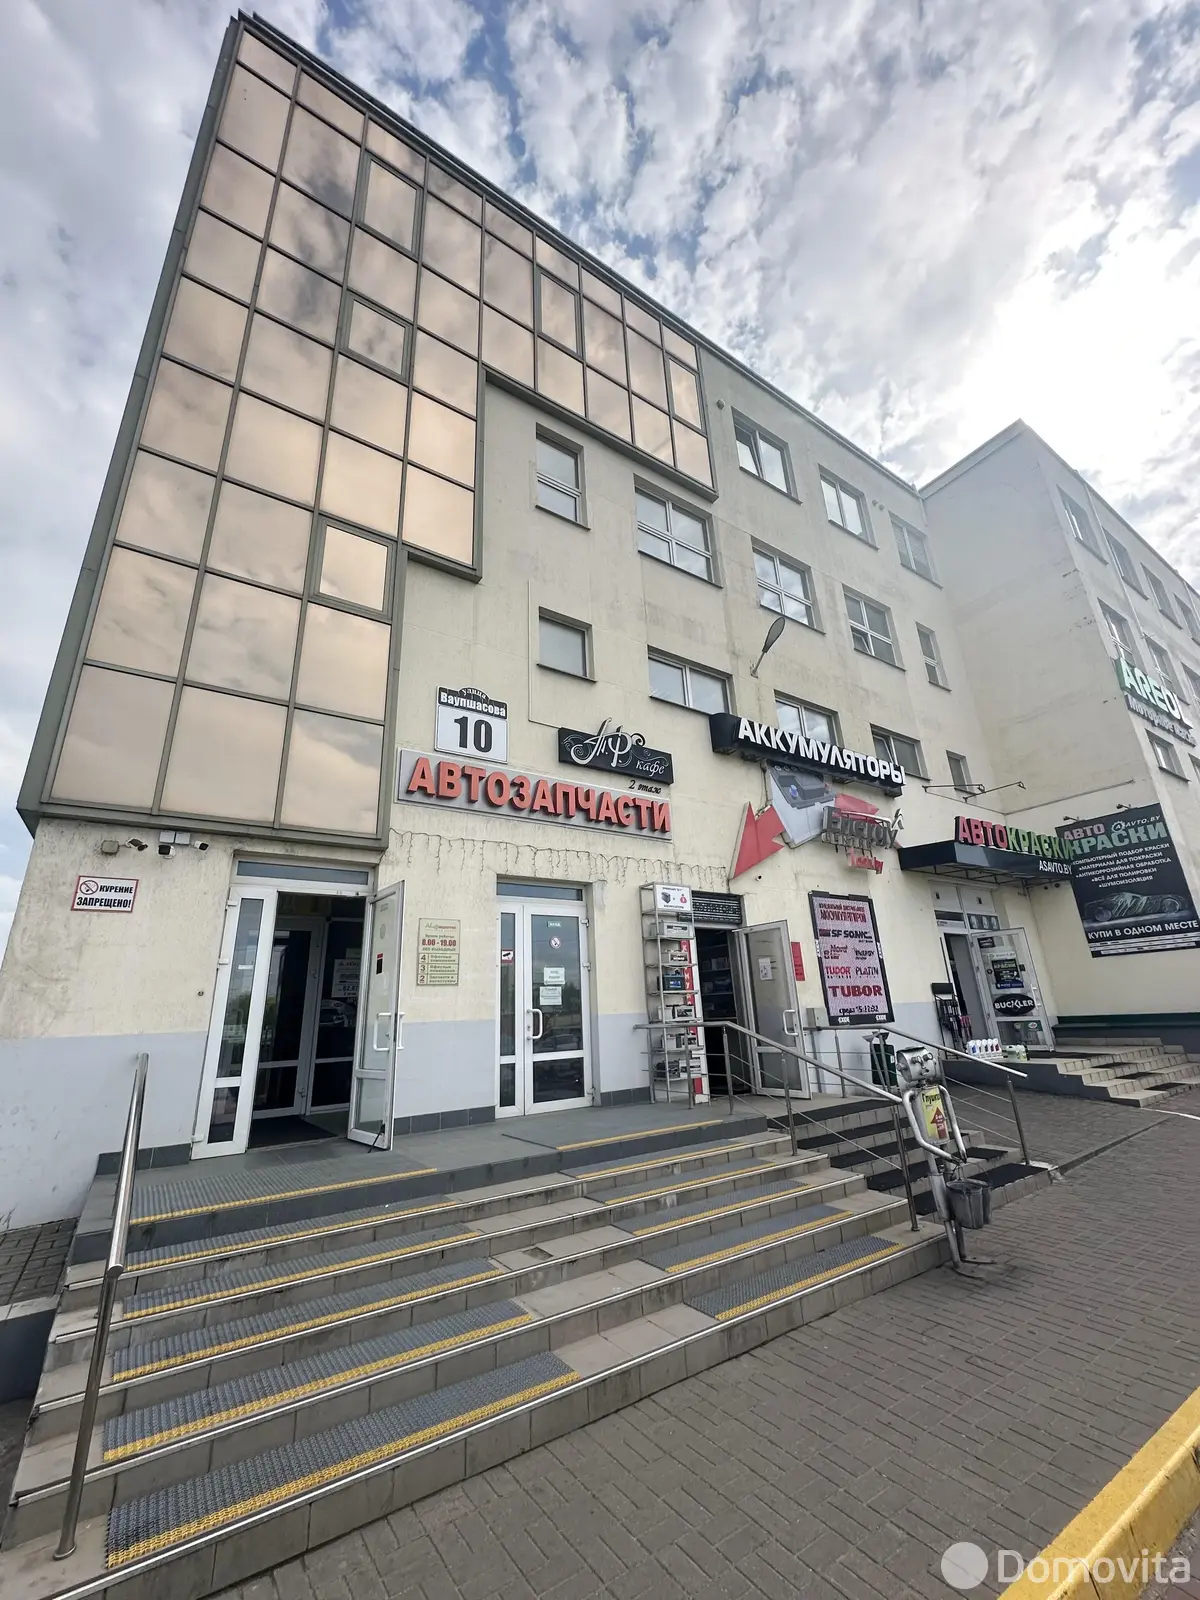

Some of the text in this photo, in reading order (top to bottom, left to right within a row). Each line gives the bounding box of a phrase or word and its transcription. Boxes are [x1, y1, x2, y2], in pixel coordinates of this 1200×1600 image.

[461, 688, 487, 699] улица
[1120, 657, 1194, 730] AREOL
[440, 691, 506, 717] Ваупшасова
[454, 715, 493, 753] 10
[738, 718, 906, 785] АККУМУЛЯТОРЫ
[635, 760, 666, 777] кафе
[628, 779, 637, 790] 2
[408, 757, 670, 833] АВТОЗАПЧАСТИ
[955, 815, 1074, 861] АВТОКРАСКИ
[1064, 824, 1105, 840] АВТО
[1071, 822, 1167, 854] КРАСКИ
[1118, 847, 1144, 857] ПОДБОР
[1144, 842, 1170, 852] КРАСКИ
[1039, 860, 1073, 875] ASAVTO.BY
[1081, 851, 1163, 870] МАТЕРИАЛЫ ДЛЯ ПОКРАСКИ
[1135, 858, 1171, 868] ОБРАБОТКА
[1106, 873, 1119, 881] ДЛЯ
[1119, 867, 1157, 878] ПОЛИРОВКИ
[99, 885, 133, 894] КУРЕНИЕ
[76, 897, 131, 909] ЗАПРЕЩЕНО!
[831, 929, 842, 938] SF
[1088, 919, 1199, 940] КУПИ В ОДНОМ МЕСТЕ
[422, 938, 436, 946] 8.00
[825, 966, 879, 975] TUDOR PLATIN
[828, 985, 883, 998] TUBOR
[994, 1000, 1034, 1009] BUCKLER
